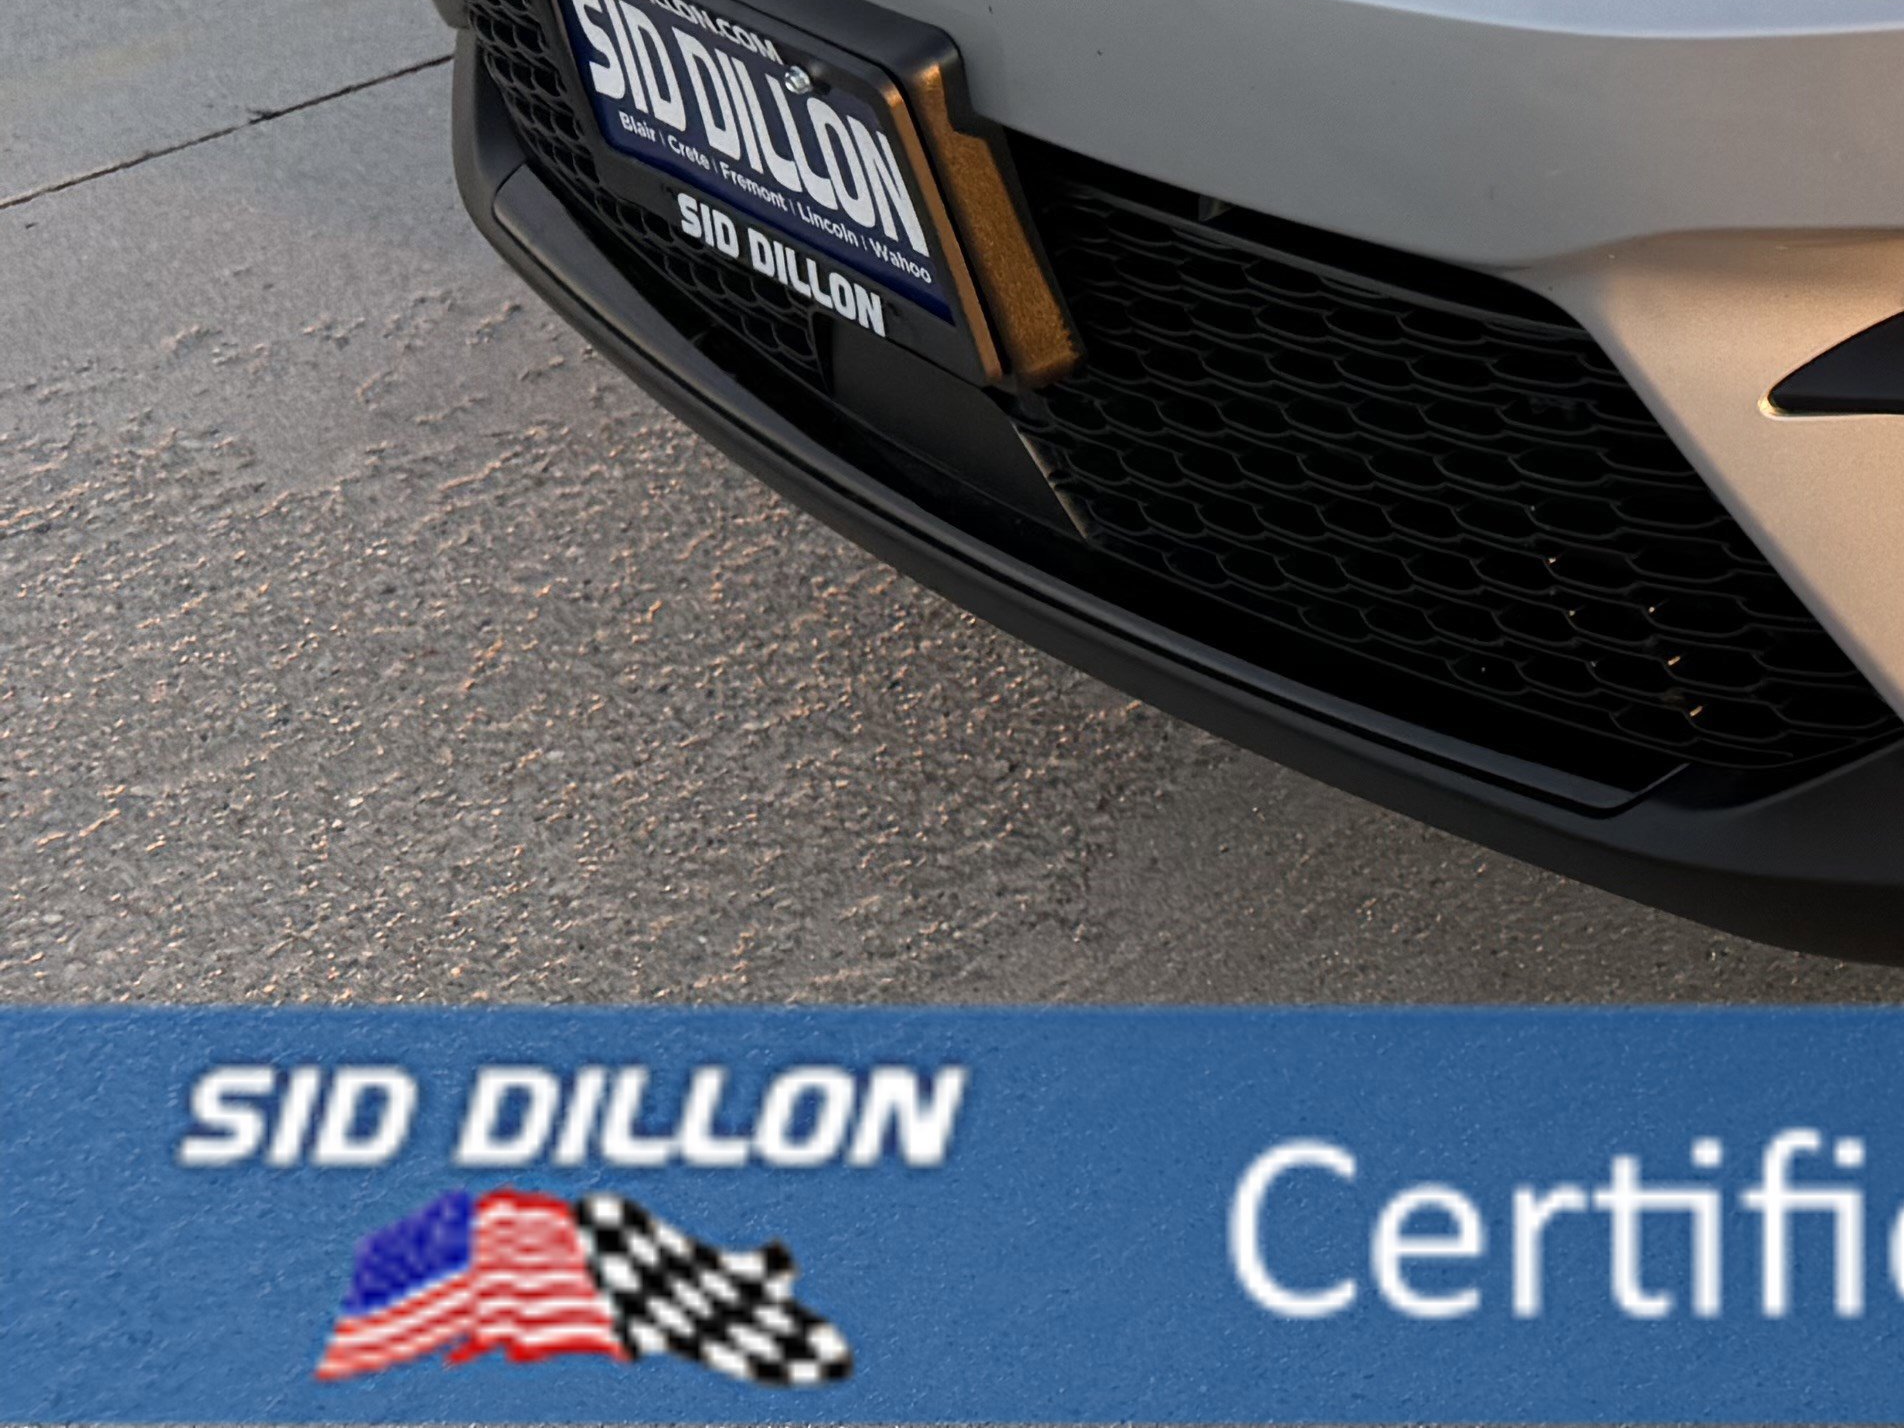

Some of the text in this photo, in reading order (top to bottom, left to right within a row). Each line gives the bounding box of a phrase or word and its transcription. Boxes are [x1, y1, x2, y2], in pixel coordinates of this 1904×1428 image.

[618, 110, 932, 284] Blair Crete Fremont Lincoln Wahoo
[672, 26, 929, 258] DILLON
[677, 192, 886, 337] SID DILLON
